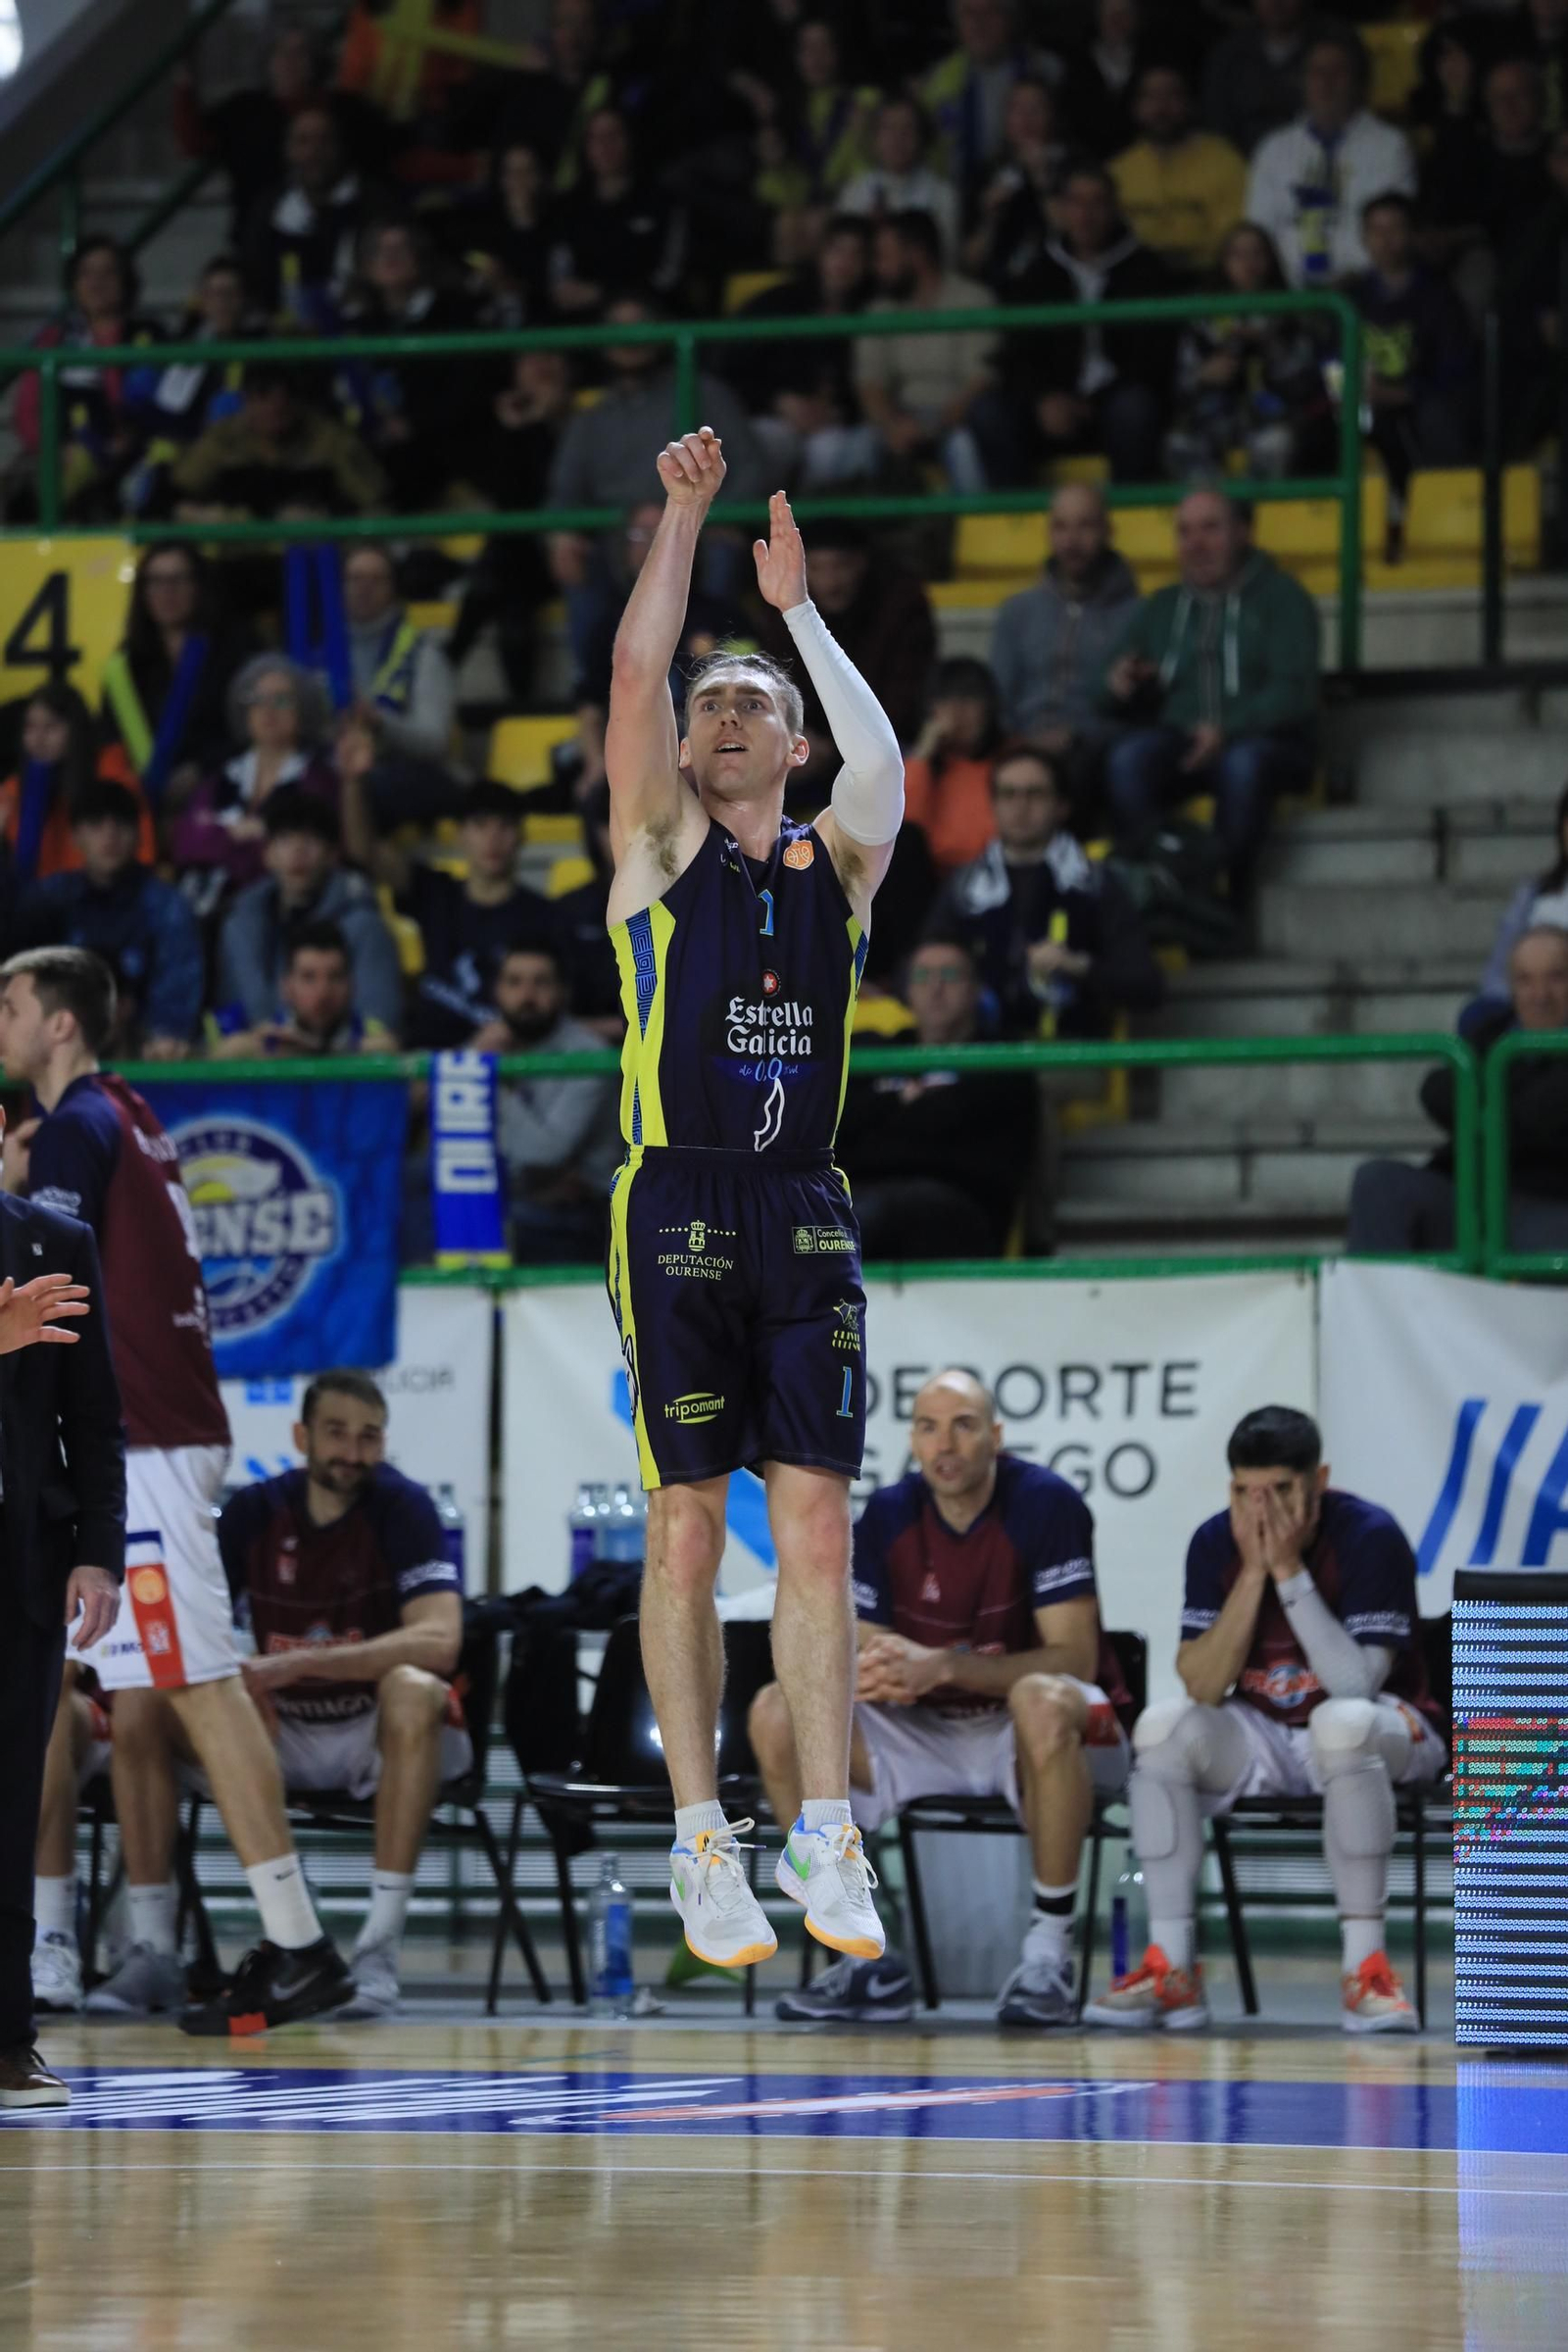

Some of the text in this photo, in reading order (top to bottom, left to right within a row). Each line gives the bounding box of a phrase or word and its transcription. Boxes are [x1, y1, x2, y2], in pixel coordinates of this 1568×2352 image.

[5, 569, 82, 681] 4
[758, 888, 774, 936] 1
[725, 996, 813, 1027] Estrella
[727, 1024, 812, 1055] Galicia
[658, 1254, 734, 1270] DEPUTACIÓN
[665, 1265, 722, 1281] OURENSE
[836, 1365, 854, 1418] 1
[663, 1396, 725, 1420] tripomant
